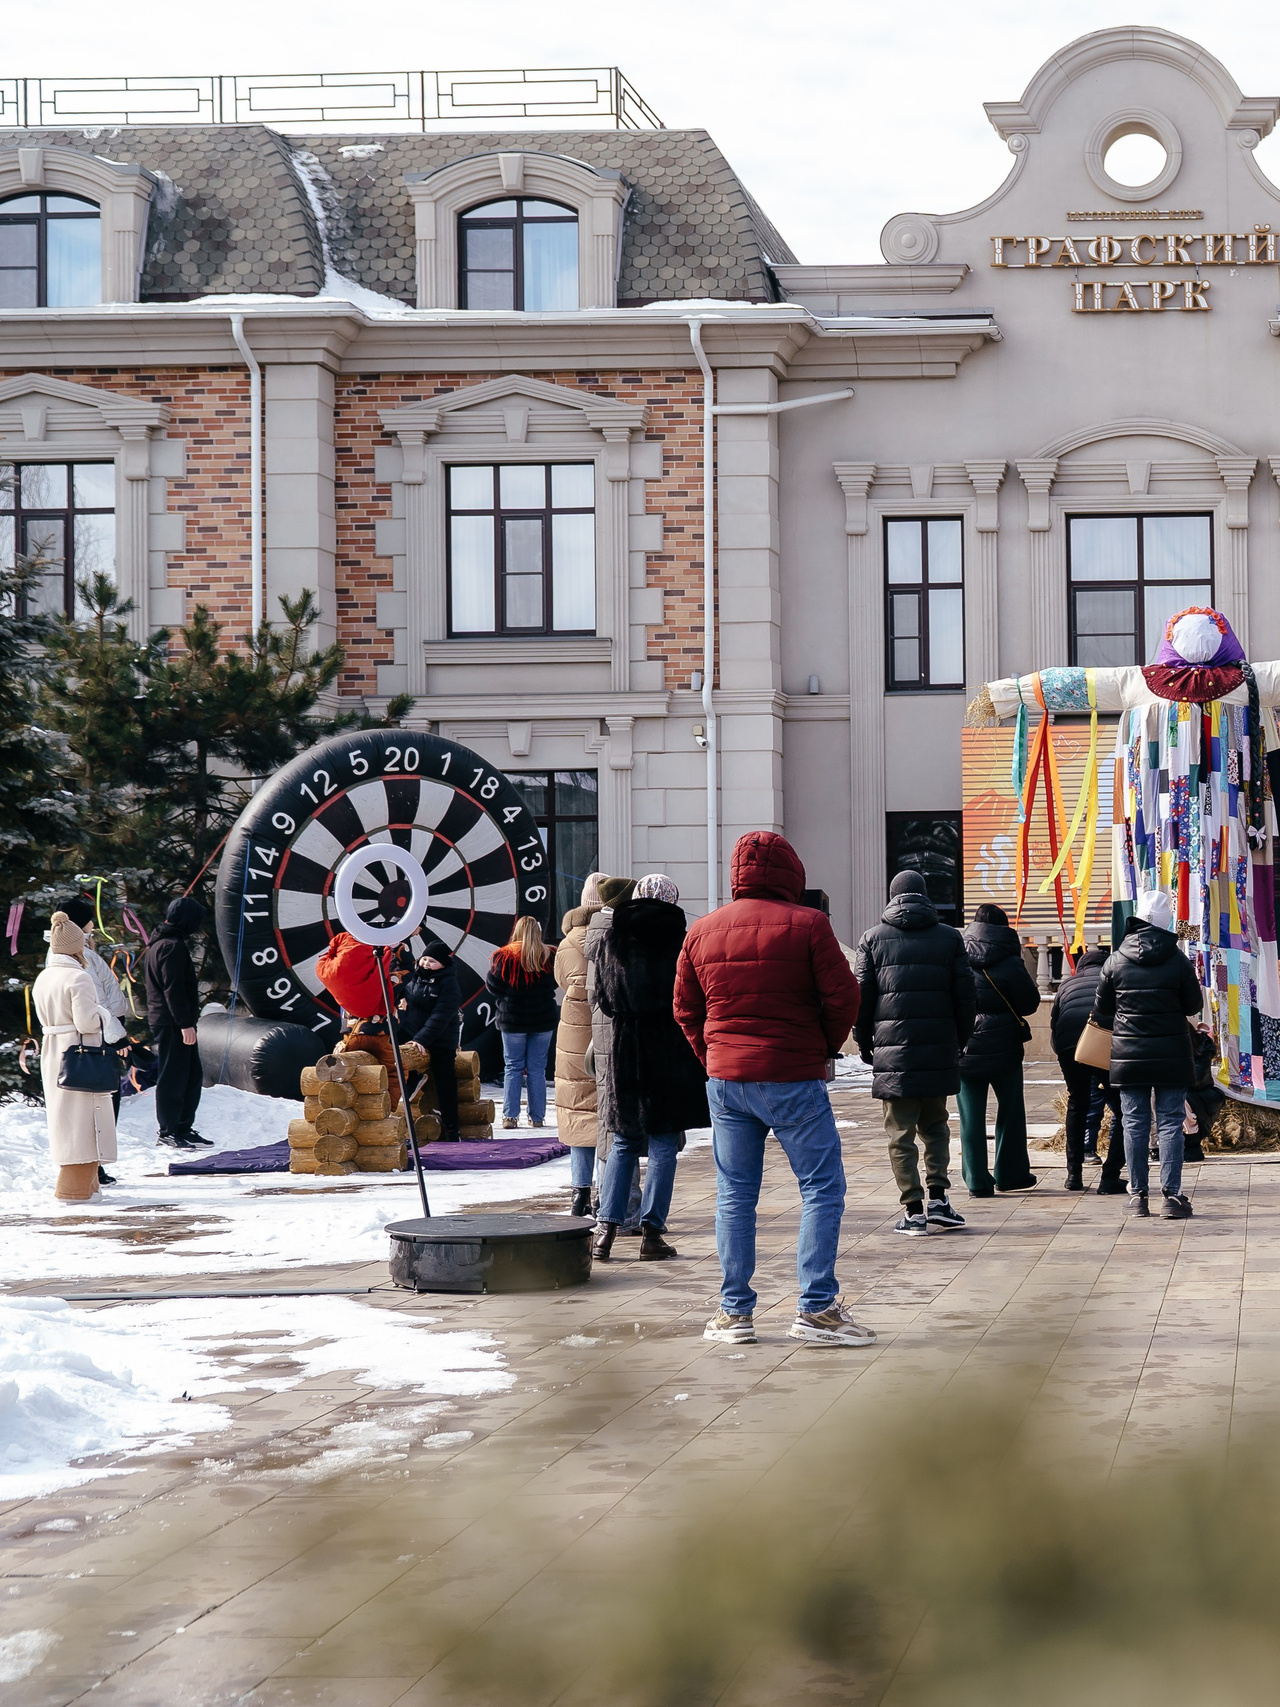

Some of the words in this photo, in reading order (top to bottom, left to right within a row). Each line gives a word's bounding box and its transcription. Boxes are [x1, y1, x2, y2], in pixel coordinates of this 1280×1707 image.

[990, 223, 1280, 267] ГРАФСКИЙ
[1071, 279, 1213, 312] ПАРК
[349, 749, 370, 776] 5
[383, 746, 420, 772] 20
[440, 751, 452, 776] 1
[300, 769, 338, 805] 12
[471, 766, 500, 800] 18
[271, 811, 296, 835] 9
[502, 804, 523, 825] 4
[248, 845, 280, 880] 14
[517, 835, 544, 872] 13
[524, 884, 548, 903] 6
[243, 893, 269, 923] 11
[251, 946, 279, 967] 8
